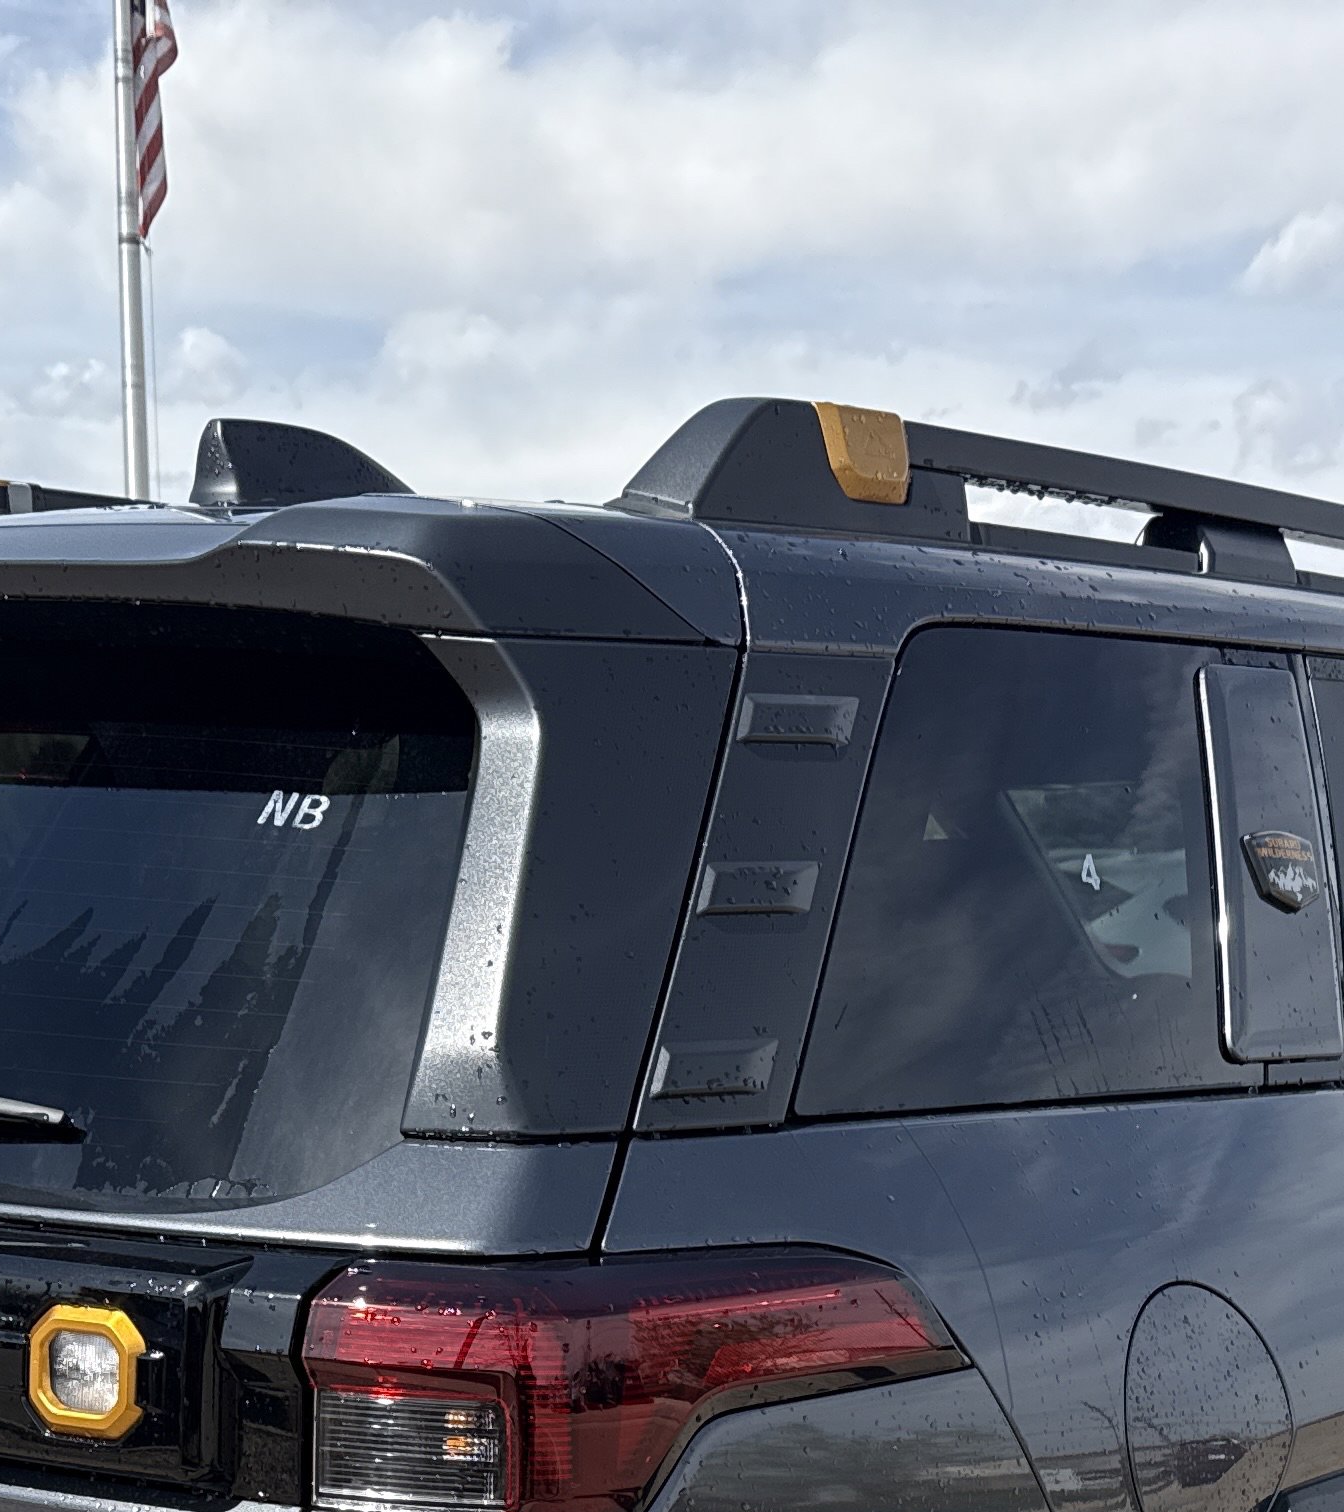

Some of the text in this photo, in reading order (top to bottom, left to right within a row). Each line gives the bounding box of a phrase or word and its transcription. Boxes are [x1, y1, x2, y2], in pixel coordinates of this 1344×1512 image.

[256, 789, 331, 830] NB
[1256, 847, 1314, 861] WILDERNESS
[1265, 837, 1301, 850] SUBARU
[1081, 853, 1101, 891] 4
